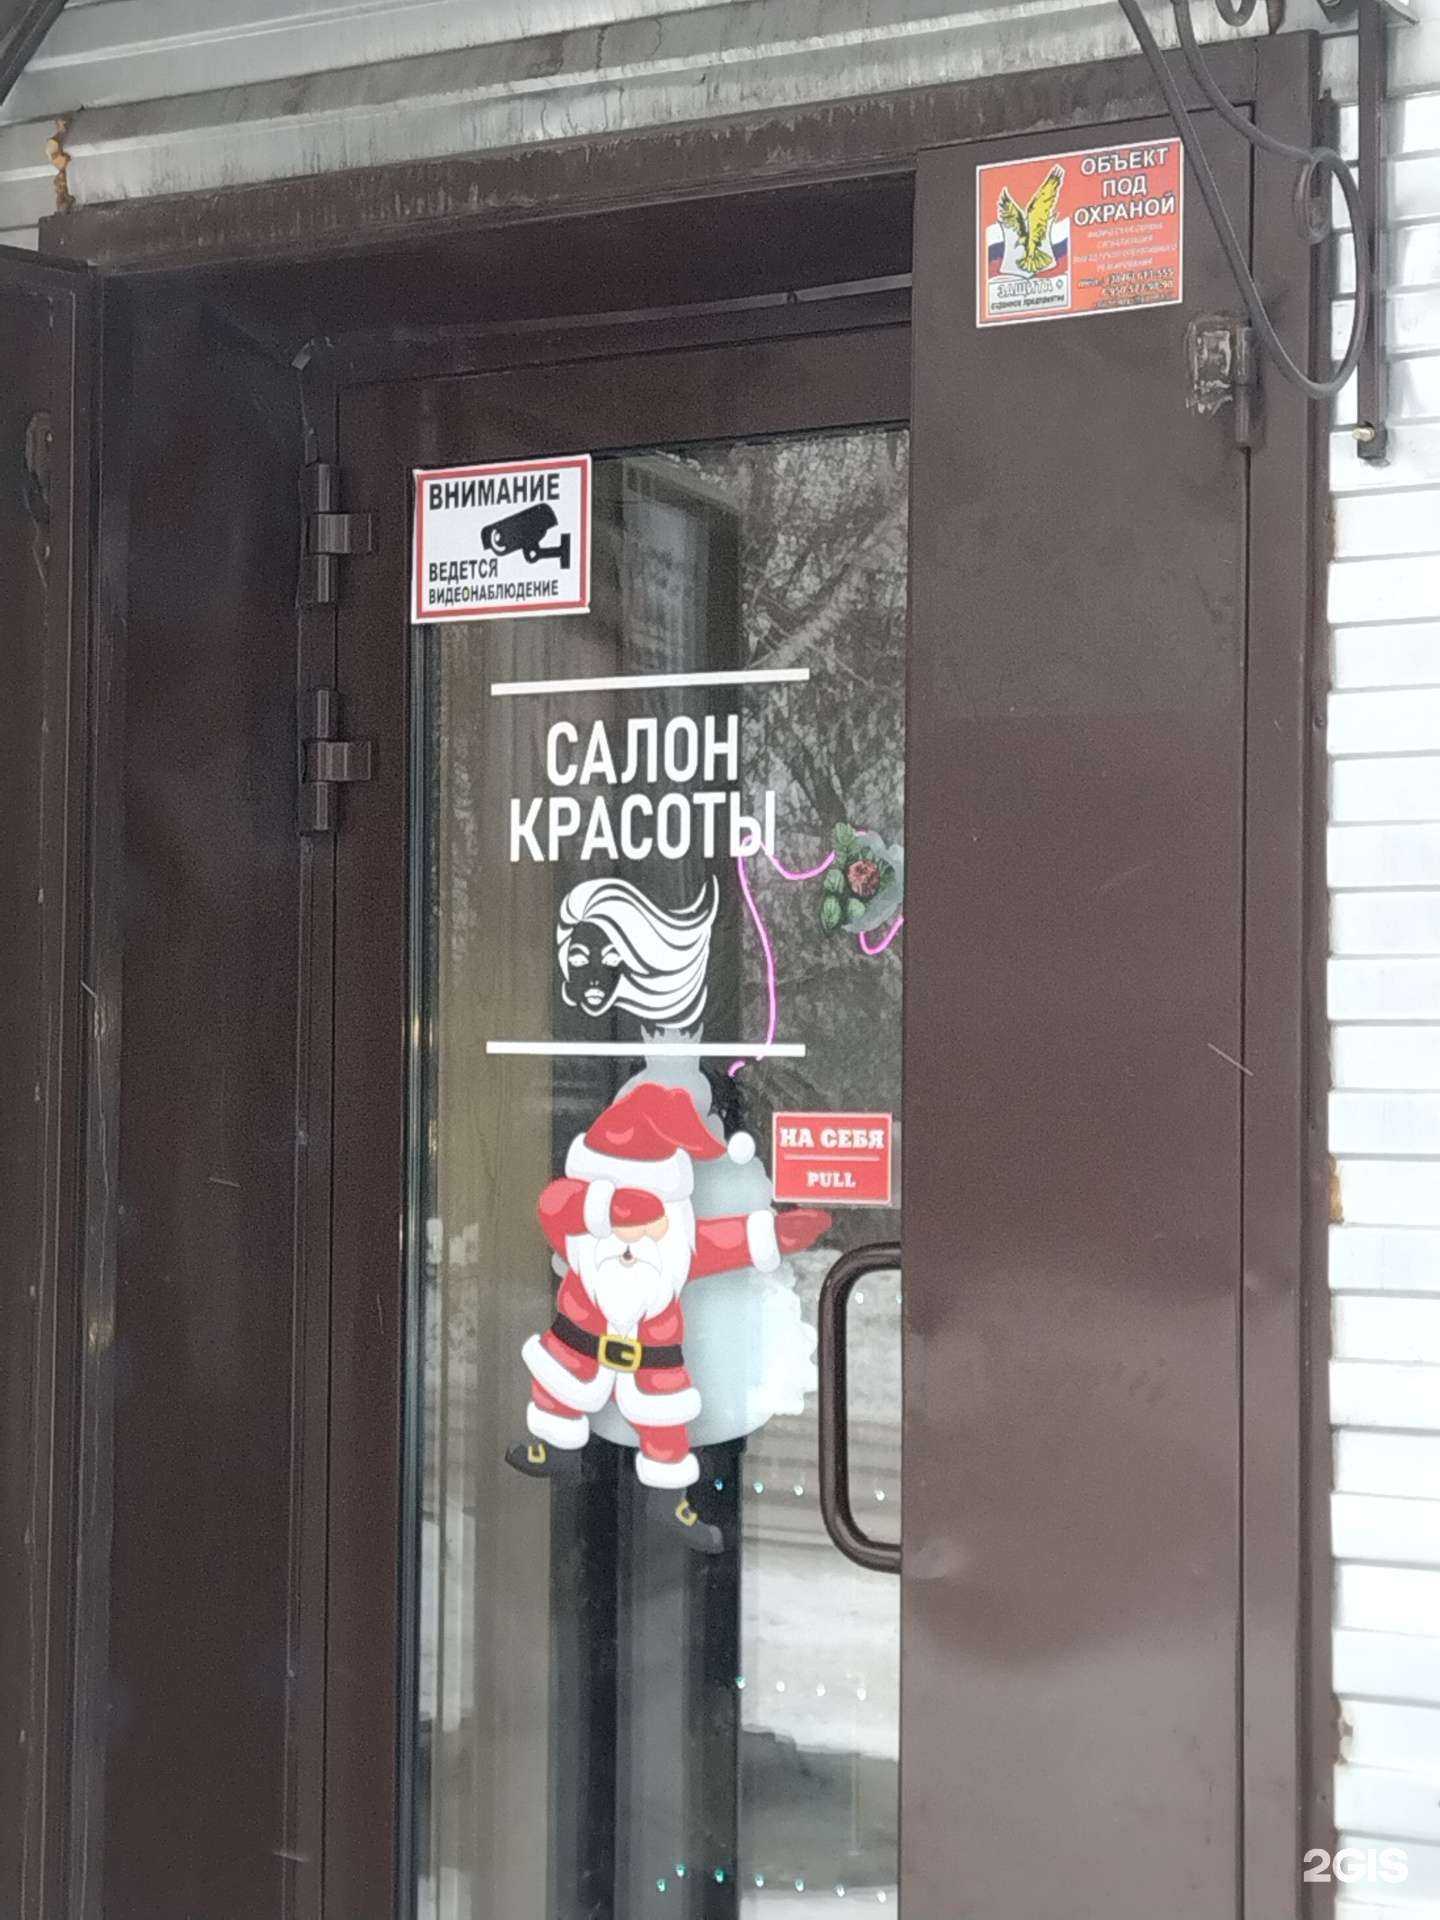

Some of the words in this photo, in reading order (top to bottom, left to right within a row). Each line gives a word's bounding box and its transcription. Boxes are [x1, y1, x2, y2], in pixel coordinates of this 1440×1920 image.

[1080, 147, 1169, 176] ОБЪЕКТ
[1102, 175, 1148, 199] ПОД
[1074, 192, 1175, 226] ОХРАНОЙ
[429, 473, 560, 510] ВНИМАНИЕ
[429, 558, 498, 582] ВЕДЕТСЯ
[429, 579, 559, 605] ВИДЕОНАБЛЮДЕНИЕ
[546, 714, 739, 786] САЛОН
[509, 790, 776, 862] КРАСОТЫ
[780, 1128, 815, 1148] НА
[820, 1128, 884, 1149] СЕБЯ
[806, 1171, 857, 1188] PULL
